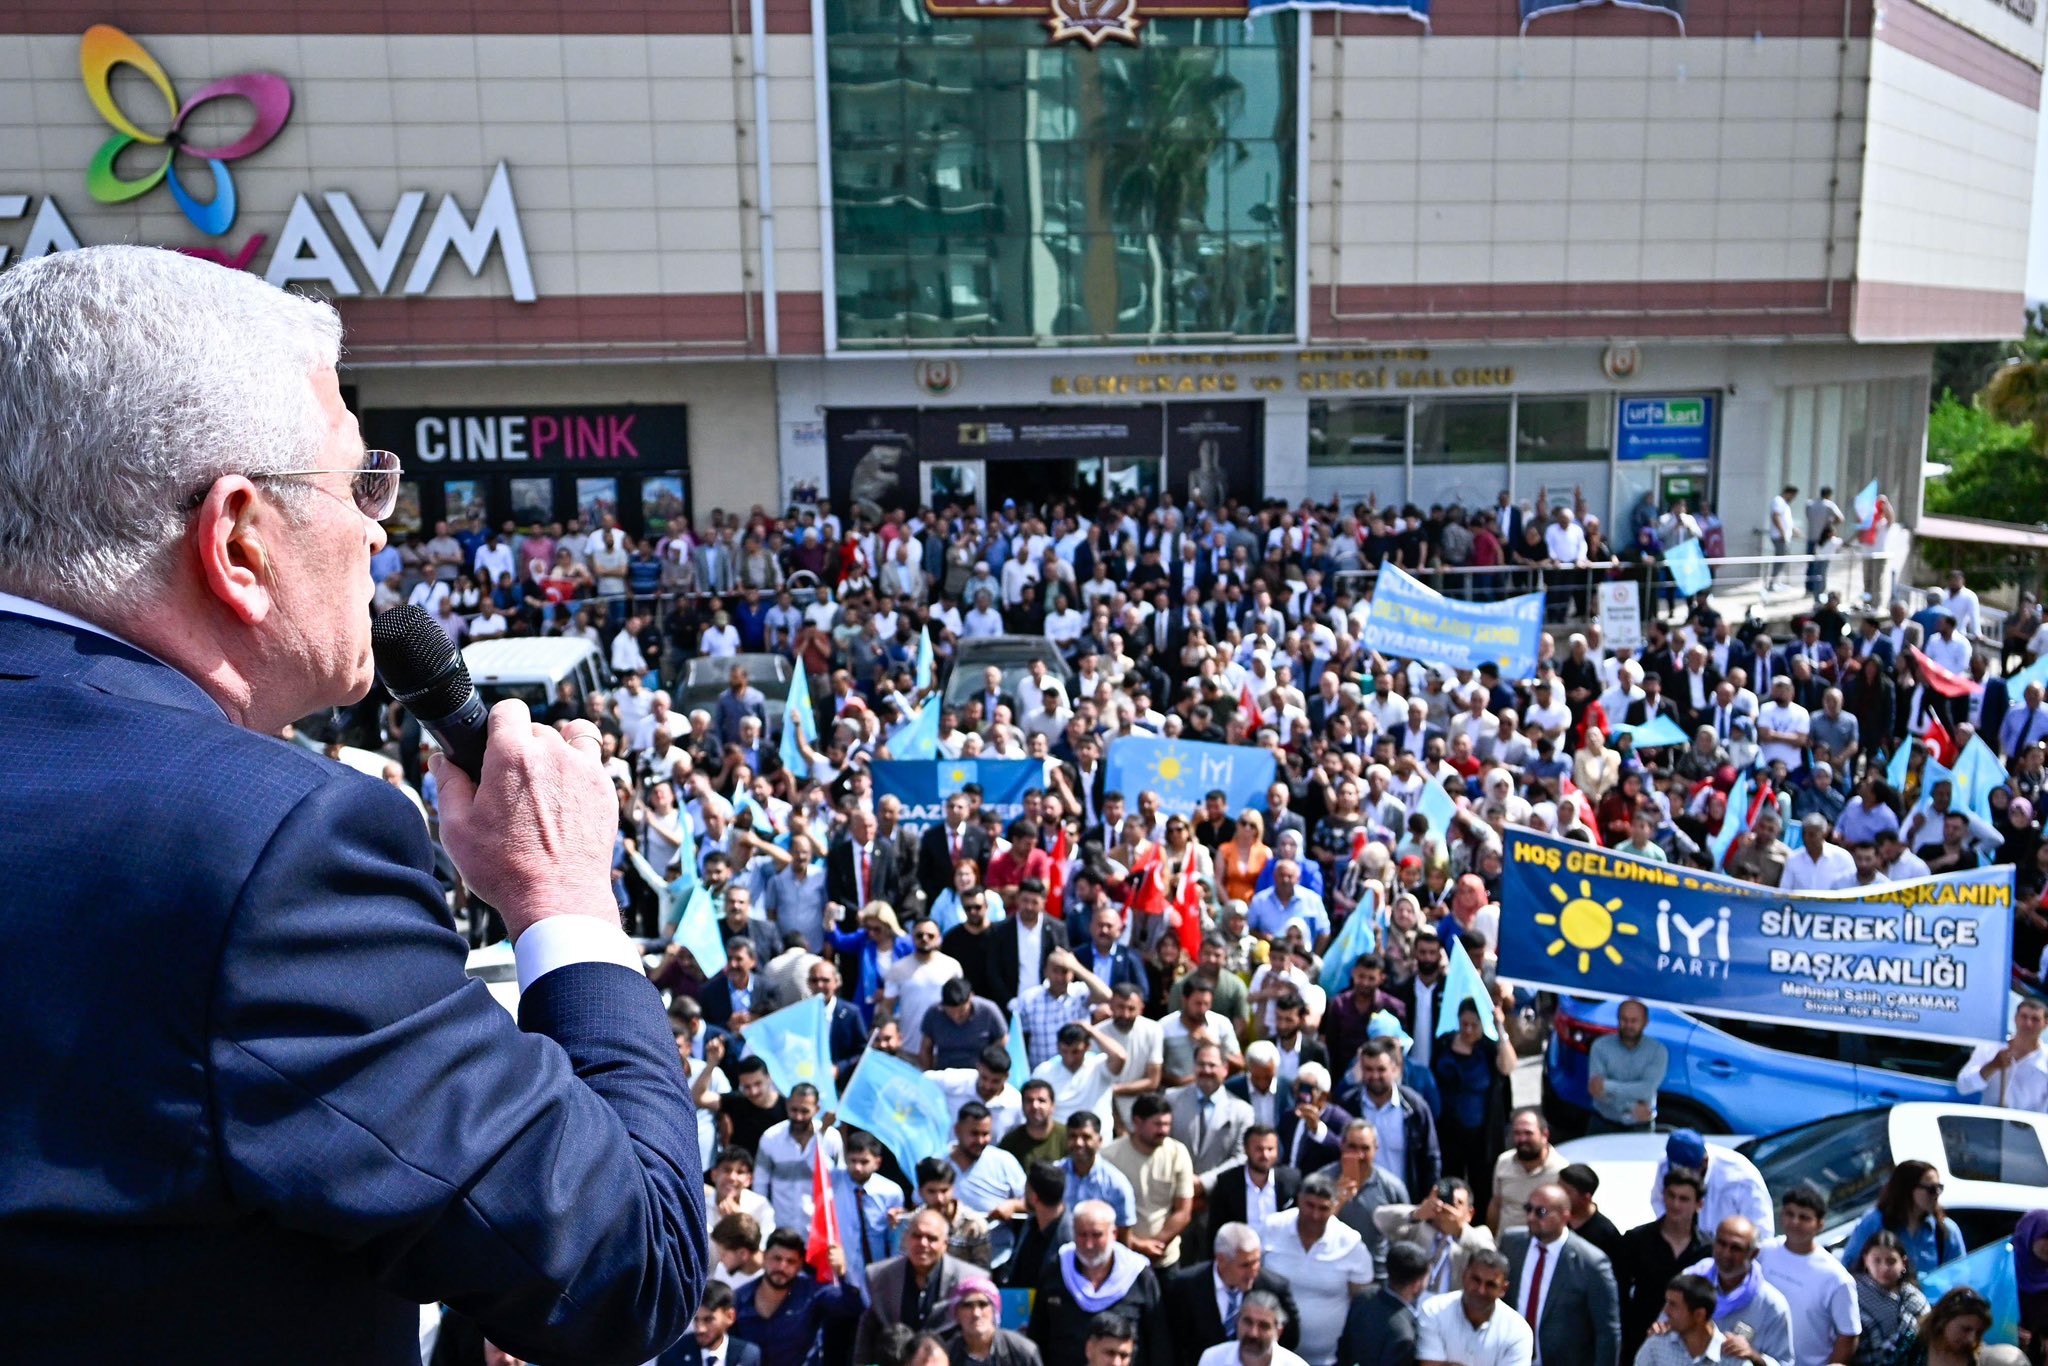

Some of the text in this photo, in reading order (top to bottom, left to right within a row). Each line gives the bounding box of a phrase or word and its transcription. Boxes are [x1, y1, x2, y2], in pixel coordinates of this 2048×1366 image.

[266, 158, 538, 303] AVM
[1513, 840, 1561, 872] HOŞ
[1656, 898, 1732, 962] İYİ
[1760, 903, 1979, 949] SİVEREK İLÇE
[1769, 948, 1967, 989] BAŞKANLIĞI
[1781, 980, 1960, 1013] Mehmet Salih ÇAKMAK
[1804, 1000, 1847, 1014] Siverek
